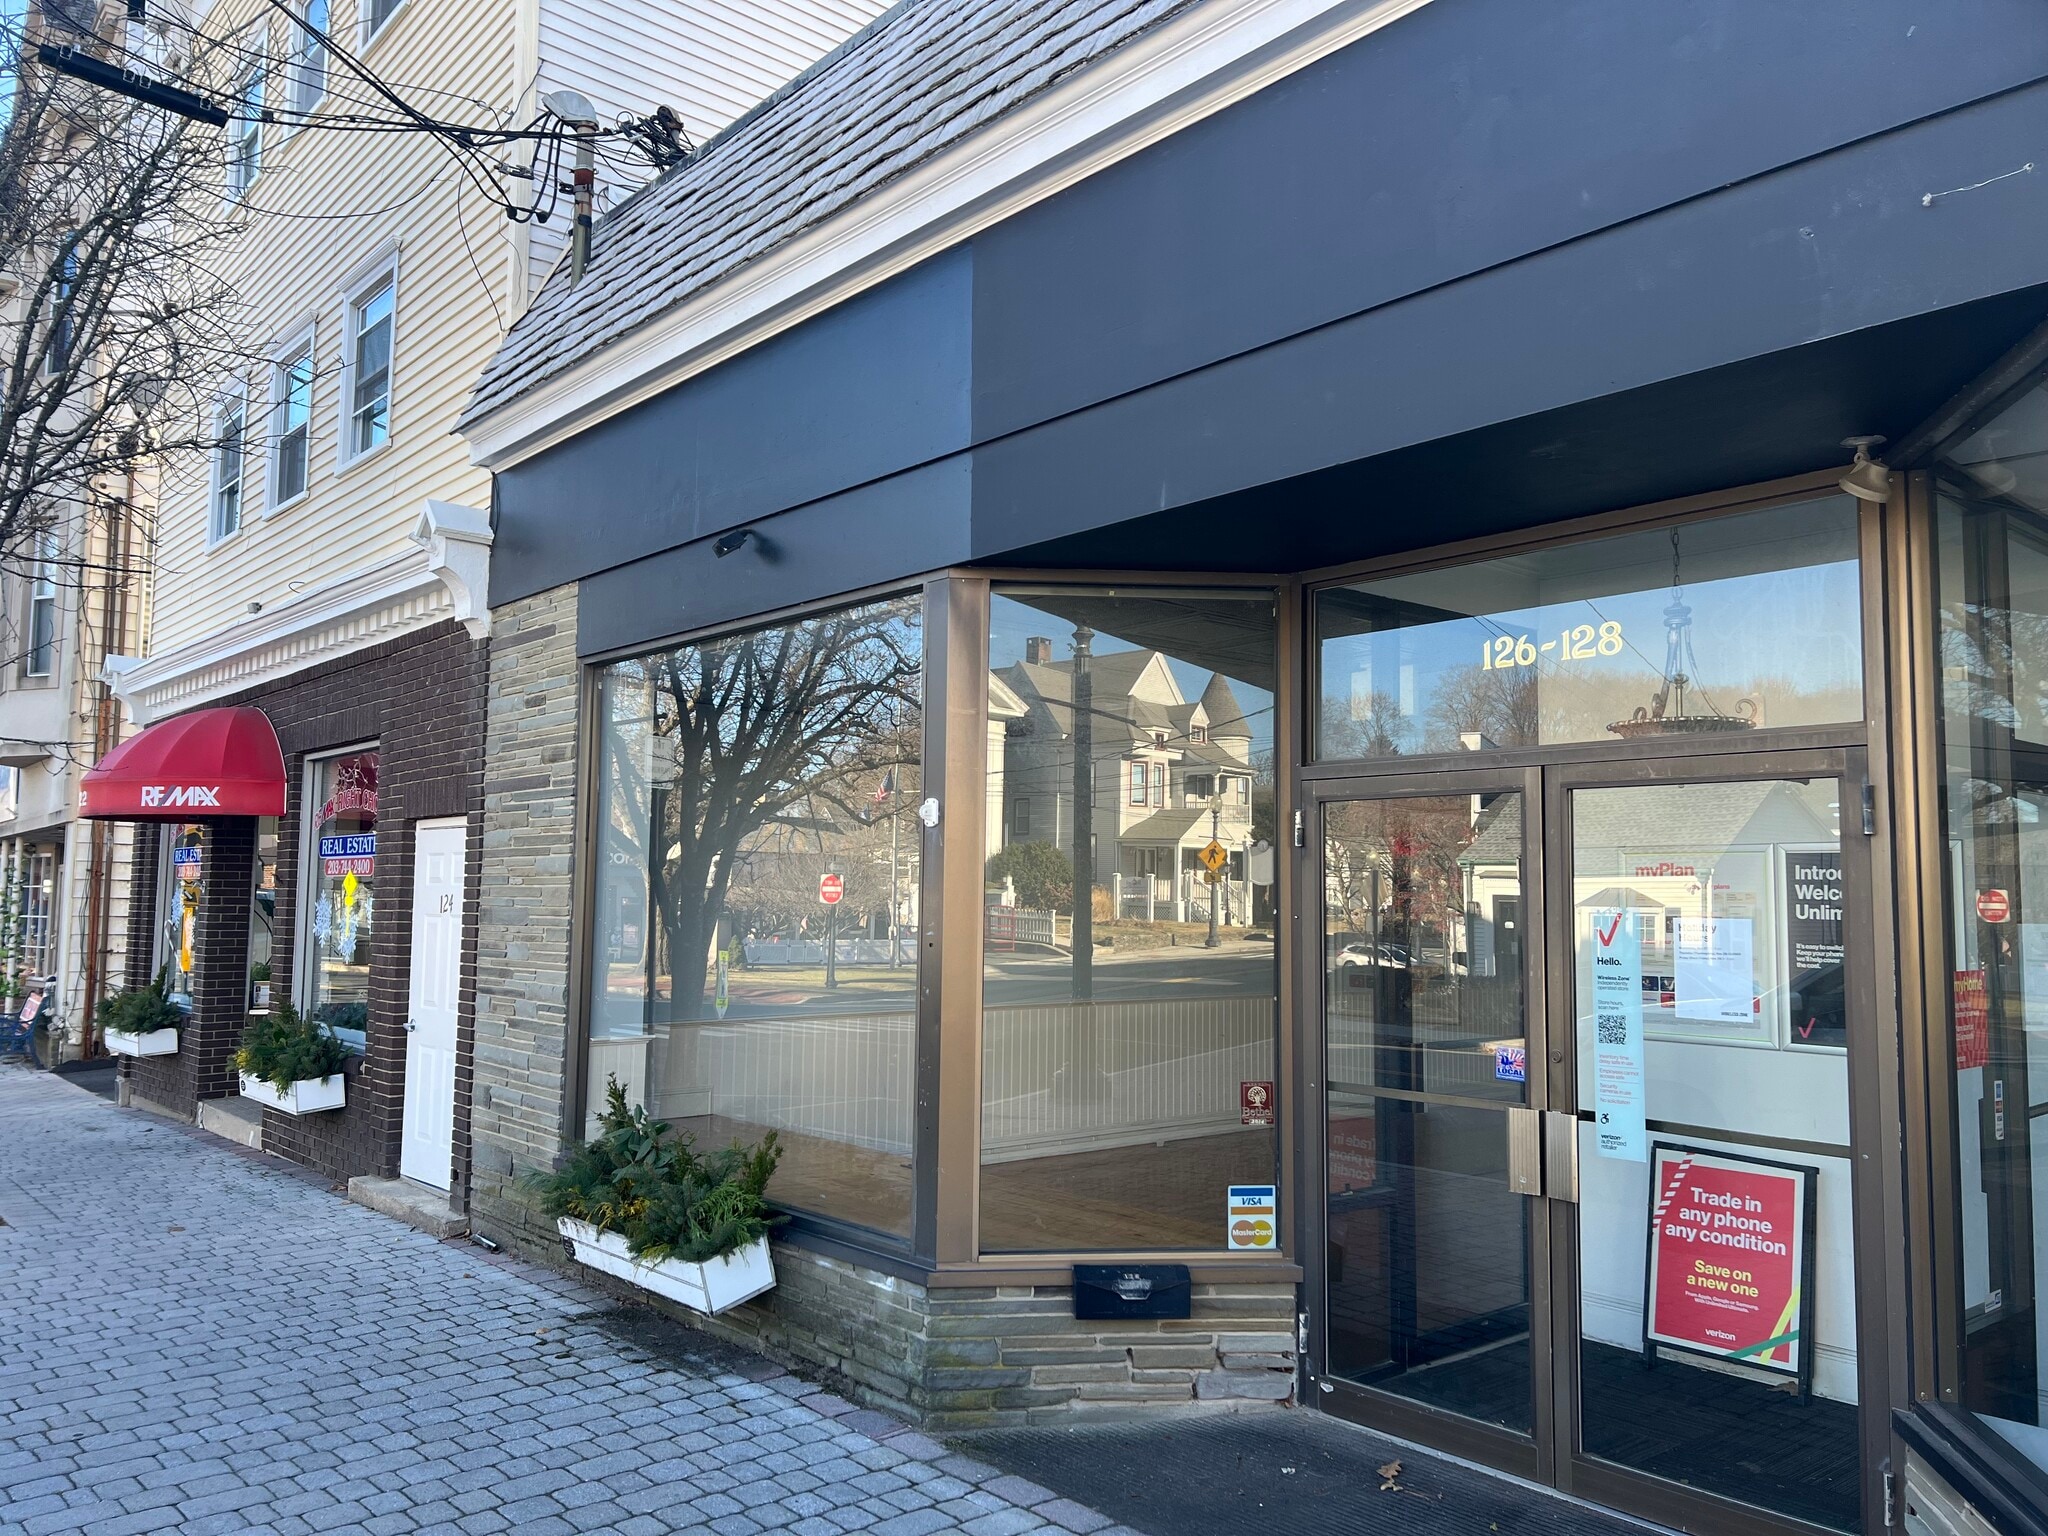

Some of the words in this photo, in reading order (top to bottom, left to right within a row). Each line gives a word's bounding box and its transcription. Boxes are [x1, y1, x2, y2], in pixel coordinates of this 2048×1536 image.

[1482, 620, 1624, 671] 126-128
[338, 787, 362, 813] RIGHT
[322, 838, 345, 856] REAL
[440, 894, 453, 914] 124
[1597, 957, 1622, 966] Hello.
[1497, 1067, 1523, 1076] LOCAL
[1241, 1106, 1273, 1117] Bethel
[1241, 1197, 1262, 1206] VISA
[1690, 1186, 1742, 1210] Trade
[1745, 1195, 1762, 1213] in
[1679, 1206, 1711, 1225] any
[1714, 1210, 1773, 1234] phone
[1232, 1229, 1272, 1237] MasterCard
[1665, 1223, 1697, 1243] any
[1699, 1229, 1787, 1256] condition
[1694, 1259, 1730, 1278] Save
[1732, 1268, 1752, 1282] on
[1686, 1273, 1696, 1285] a
[1697, 1276, 1728, 1292] new
[1730, 1283, 1759, 1298] one
[1705, 1328, 1736, 1341] verizon
